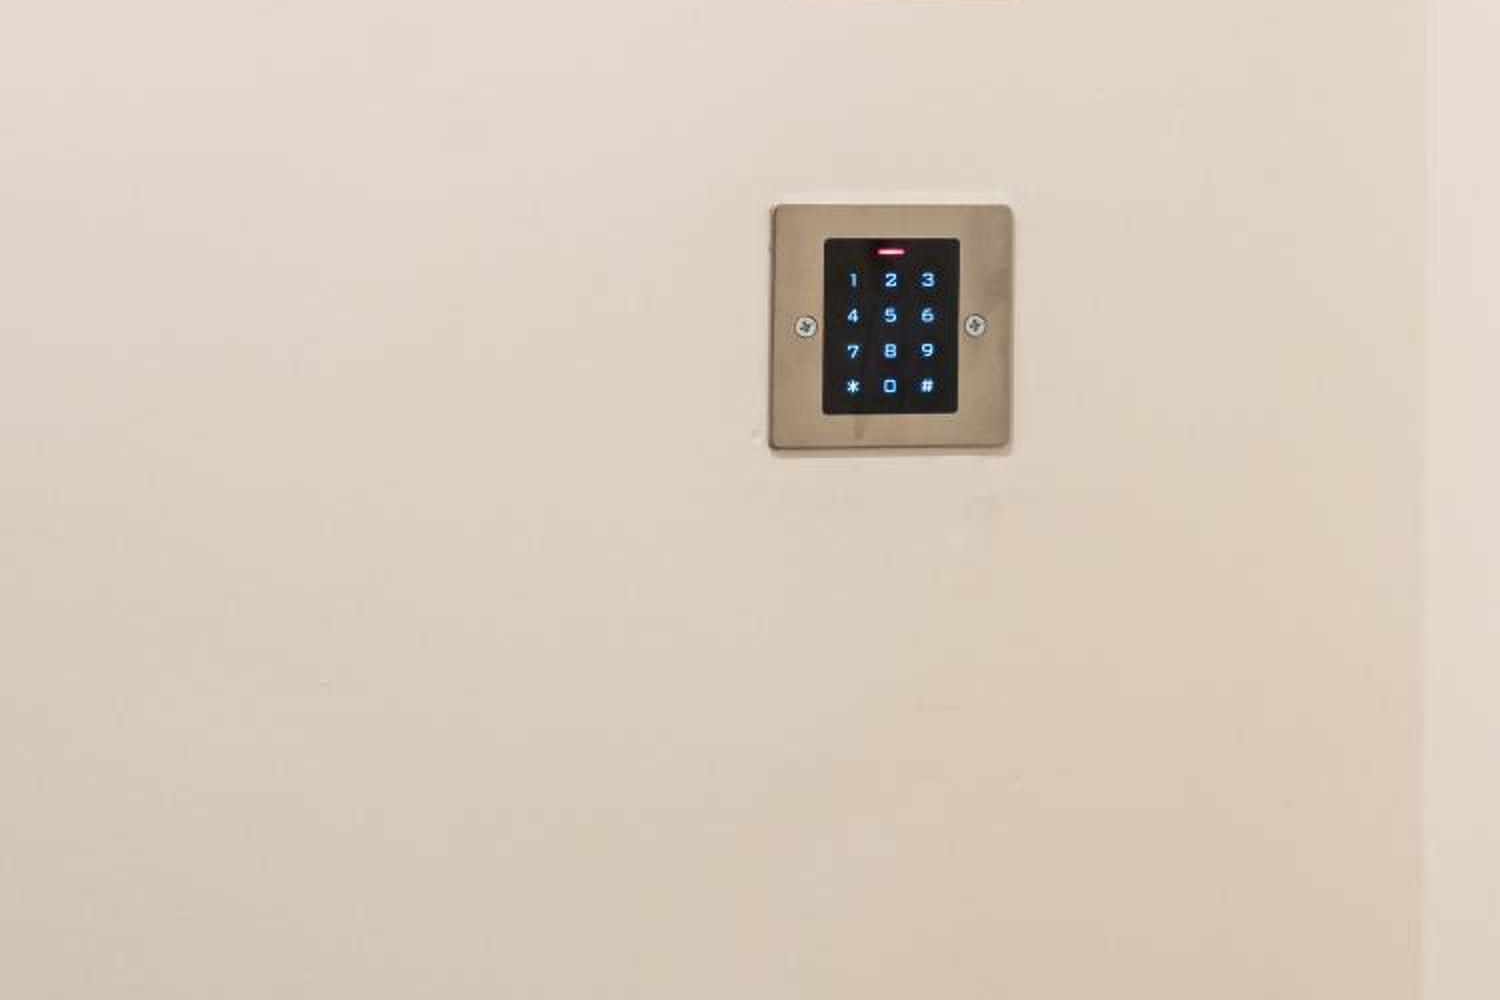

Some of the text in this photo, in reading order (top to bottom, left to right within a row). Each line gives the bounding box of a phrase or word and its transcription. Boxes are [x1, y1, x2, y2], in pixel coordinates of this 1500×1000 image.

[848, 271, 935, 288] 1 2 3
[847, 307, 935, 323] 4 5 6
[847, 343, 934, 359] 7 8 9
